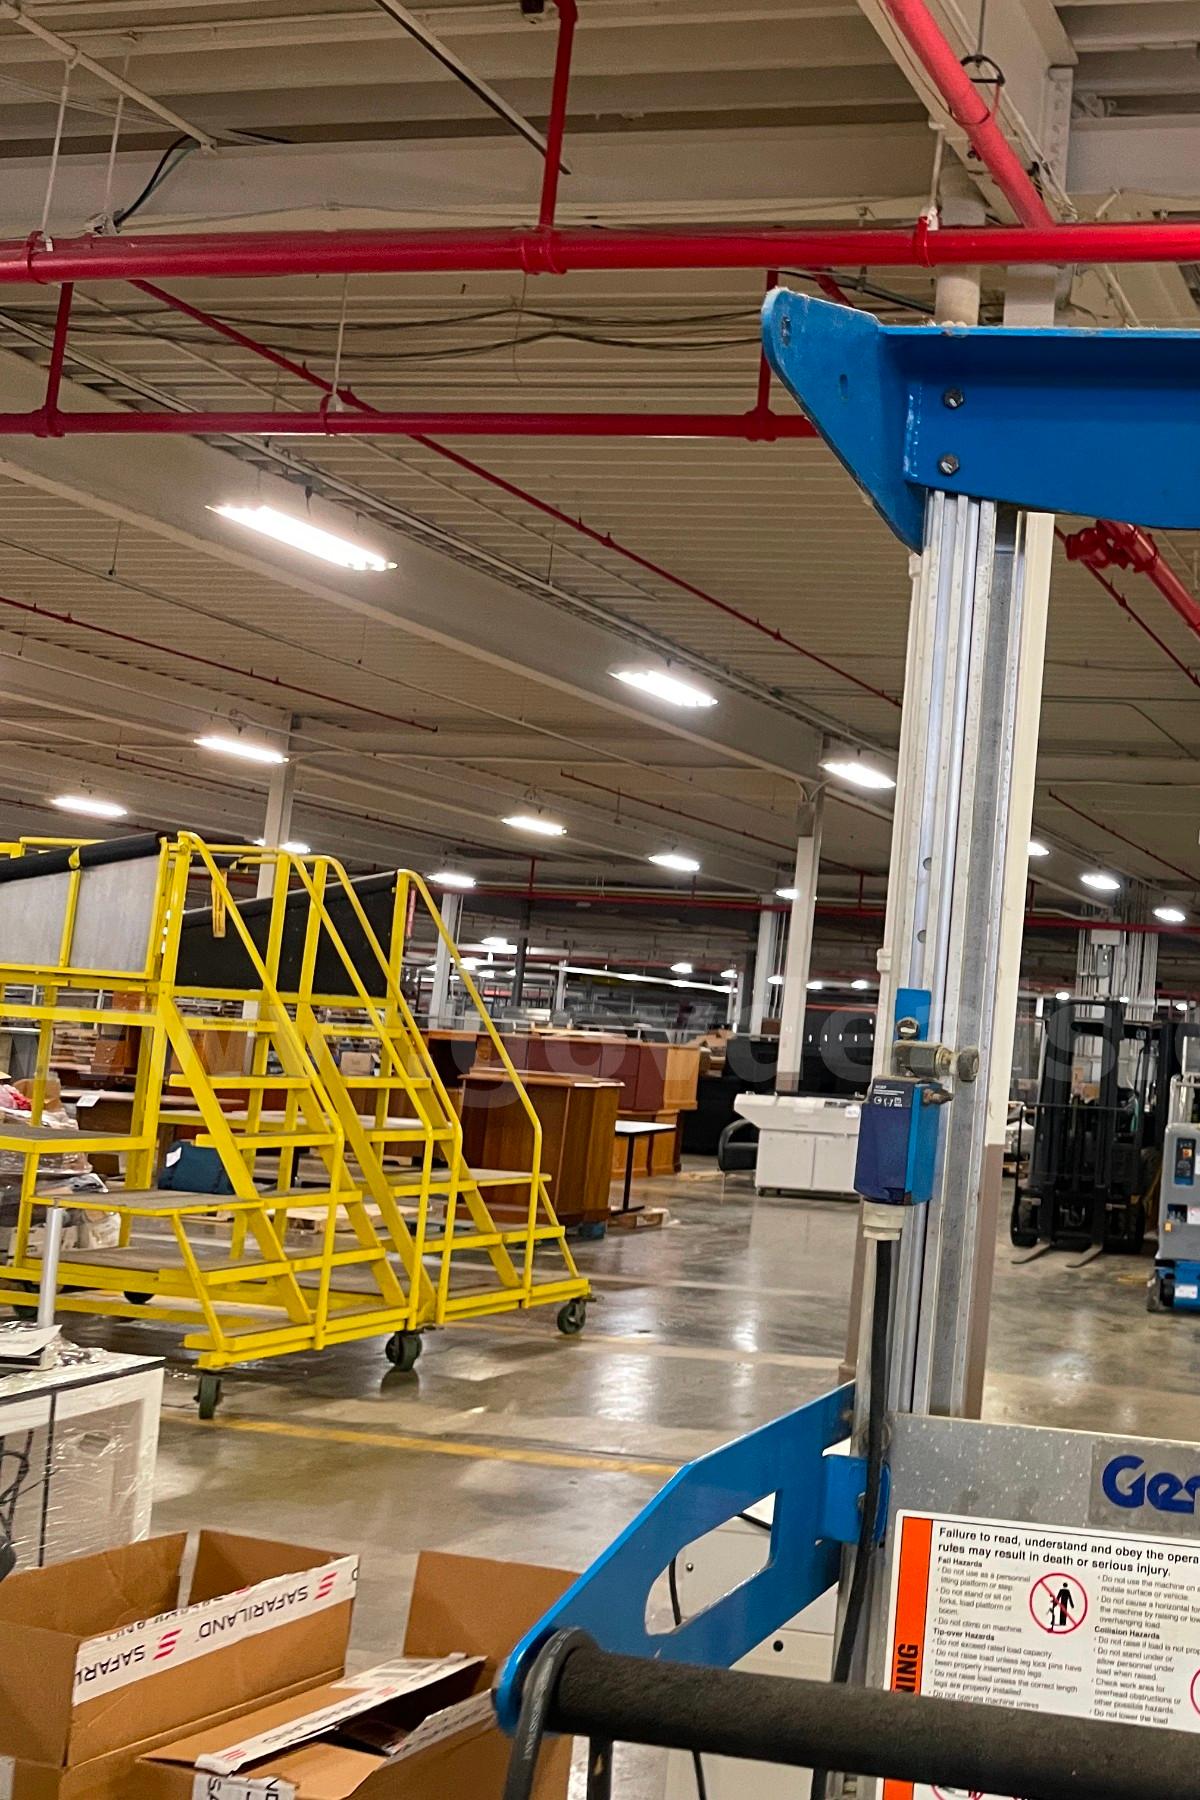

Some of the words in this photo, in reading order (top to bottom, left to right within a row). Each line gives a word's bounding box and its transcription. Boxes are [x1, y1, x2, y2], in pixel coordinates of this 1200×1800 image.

[937, 1542, 965, 1553] rules
[968, 1547, 991, 1558] may
[994, 1549, 1025, 1560] result
[1029, 1551, 1039, 1561] in
[1042, 1553, 1073, 1565] death
[1076, 1558, 1088, 1567] or
[1091, 1560, 1133, 1571] serious
[1136, 1563, 1170, 1577] injury.
[938, 1527, 976, 1540] Failure
[979, 1531, 991, 1541] to
[994, 1535, 1021, 1547] read,
[1024, 1538, 1087, 1552] understand
[1090, 1545, 1111, 1554] and
[1115, 1547, 1143, 1560] obey
[1145, 1549, 1164, 1560] the
[198, 1585, 309, 1638] SAFARILAND
